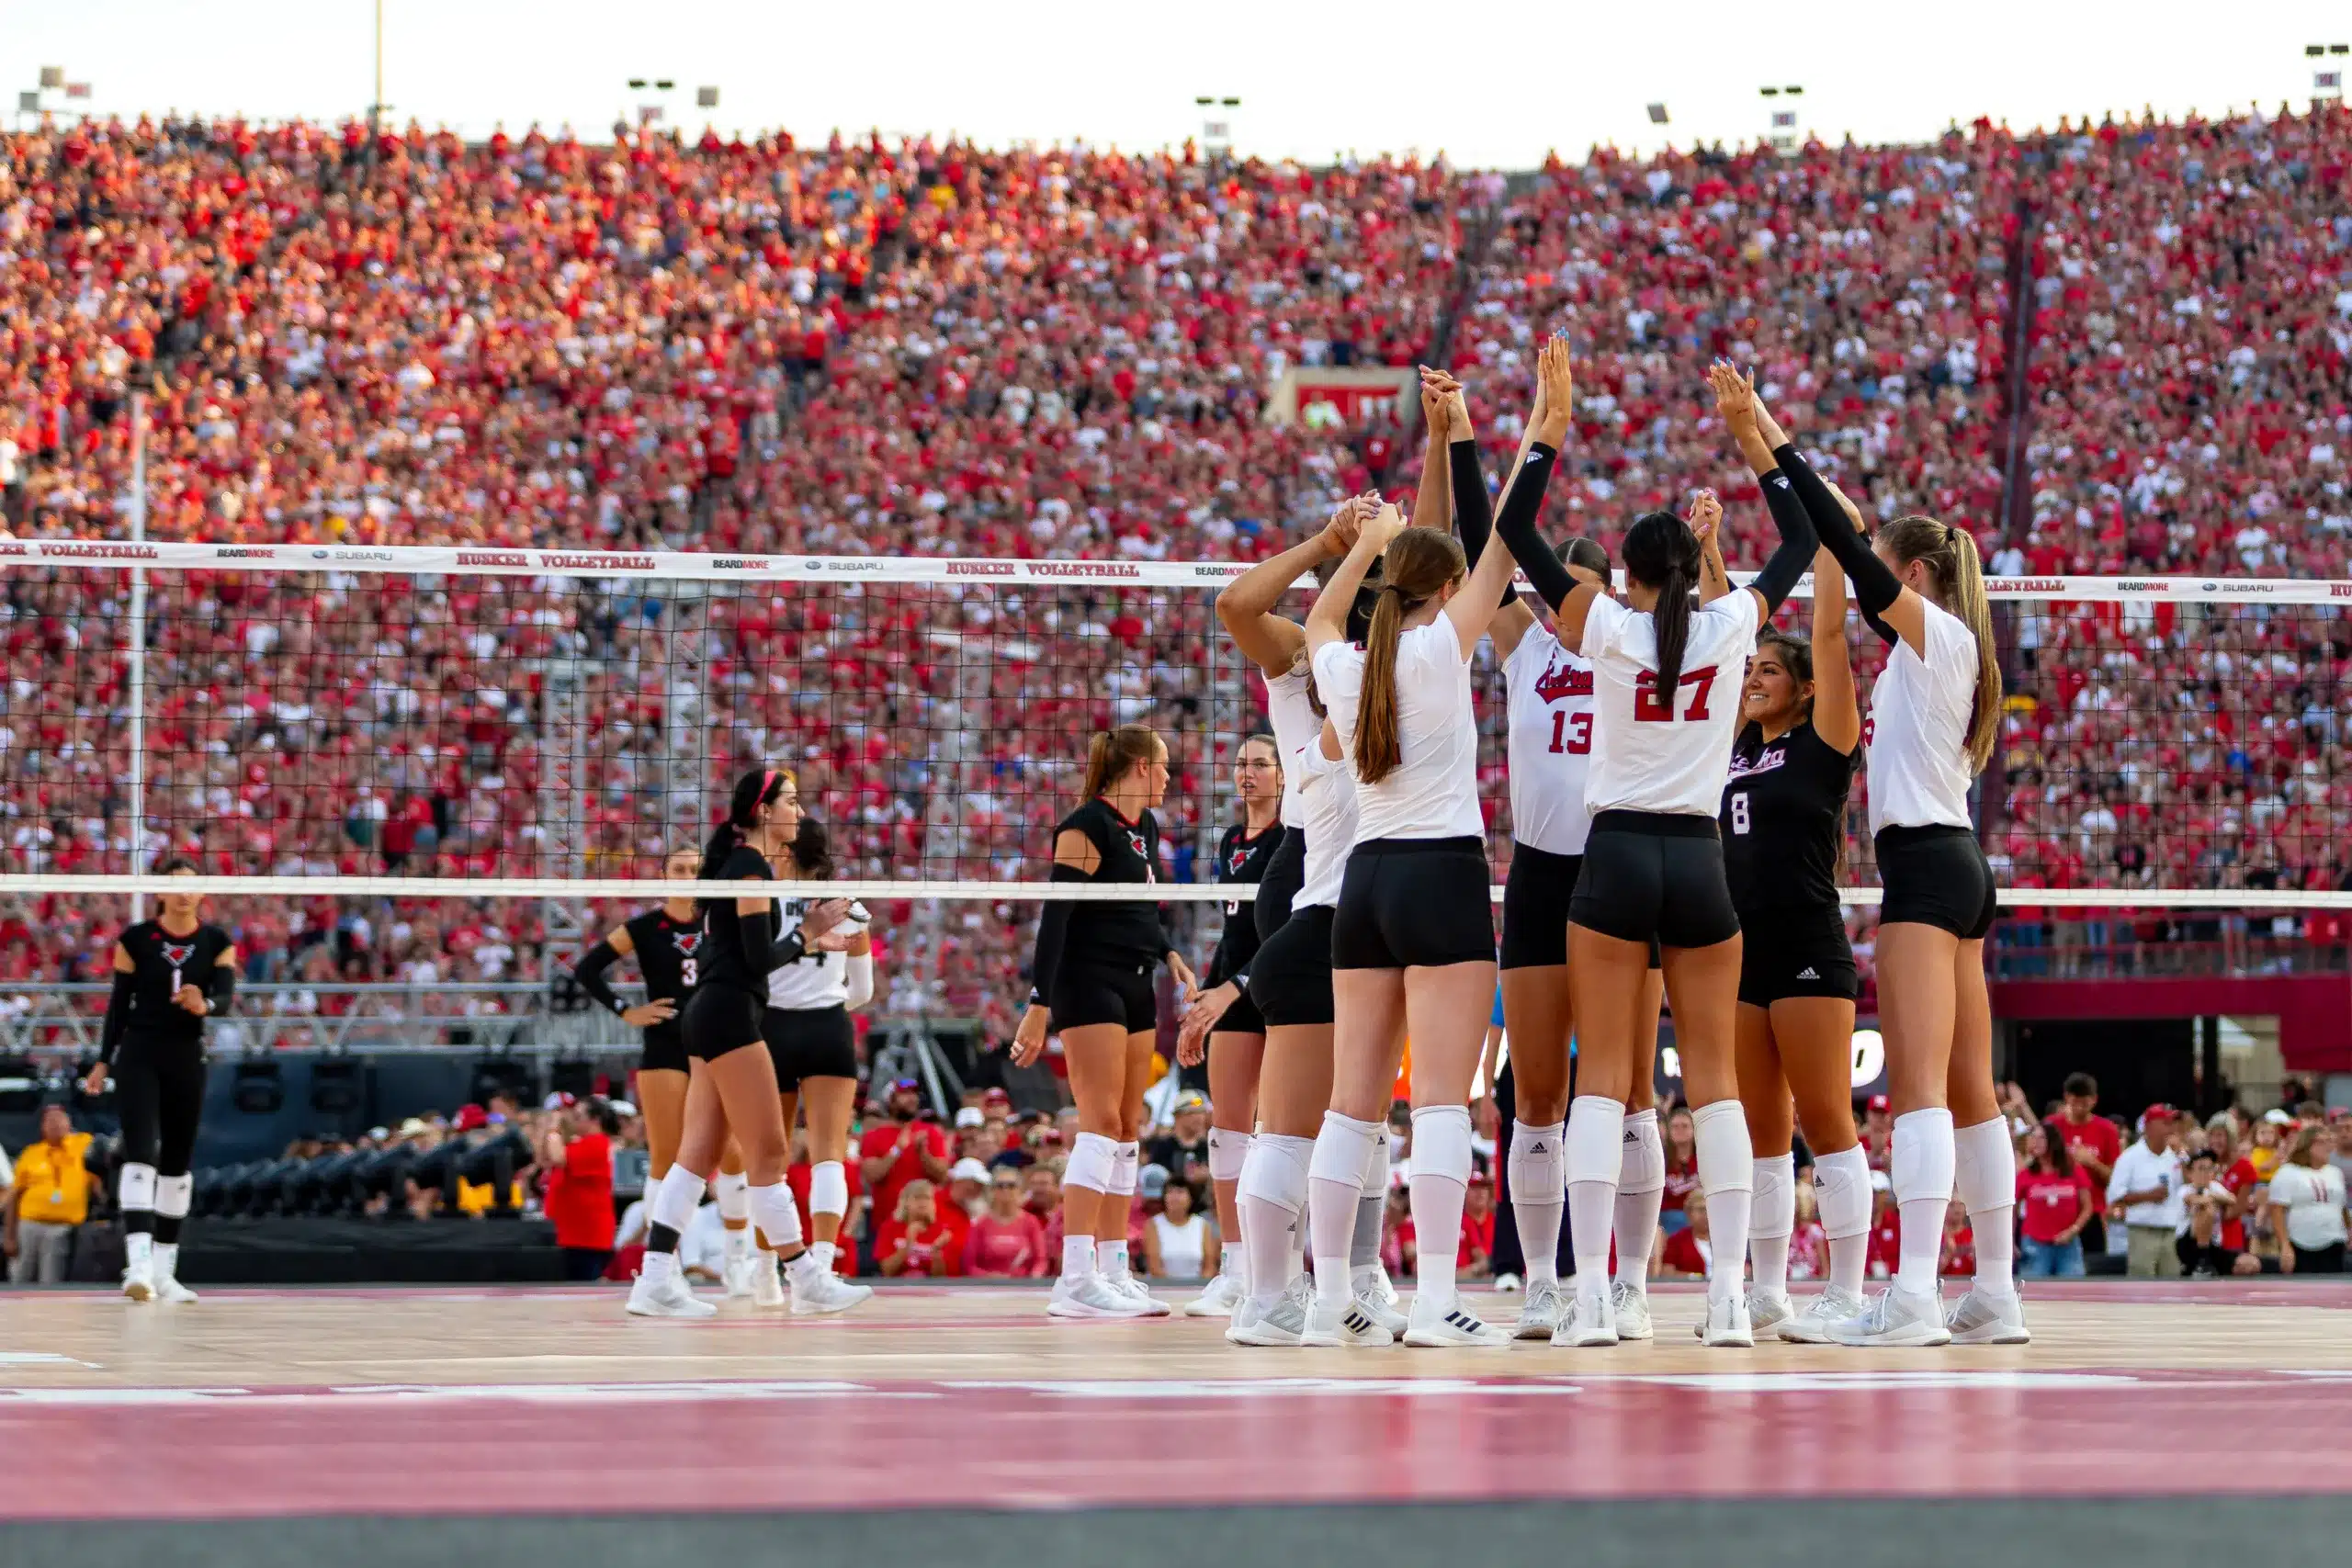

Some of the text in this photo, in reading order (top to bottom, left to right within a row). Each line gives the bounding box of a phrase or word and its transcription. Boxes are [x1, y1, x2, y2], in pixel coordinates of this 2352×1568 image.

[39, 543, 158, 558] VOLLEYBALL
[217, 548, 275, 558] BEARDMORE
[335, 550, 392, 560] SUBARU
[457, 552, 655, 570] HUSKER VOLLEYBALL
[713, 559, 769, 569] BEARDMORE
[828, 562, 884, 570] SUBARU
[946, 562, 1139, 577] HUSKER VOLLEYBALL
[1984, 580, 2065, 592] LLEYBALL
[2118, 581, 2169, 592] BEARDMORE
[2222, 583, 2274, 592] SUBARU
[1634, 666, 1720, 721] 27
[1549, 710, 1594, 755] 13
[1731, 792, 1750, 835] 8
[682, 958, 698, 987] 3
